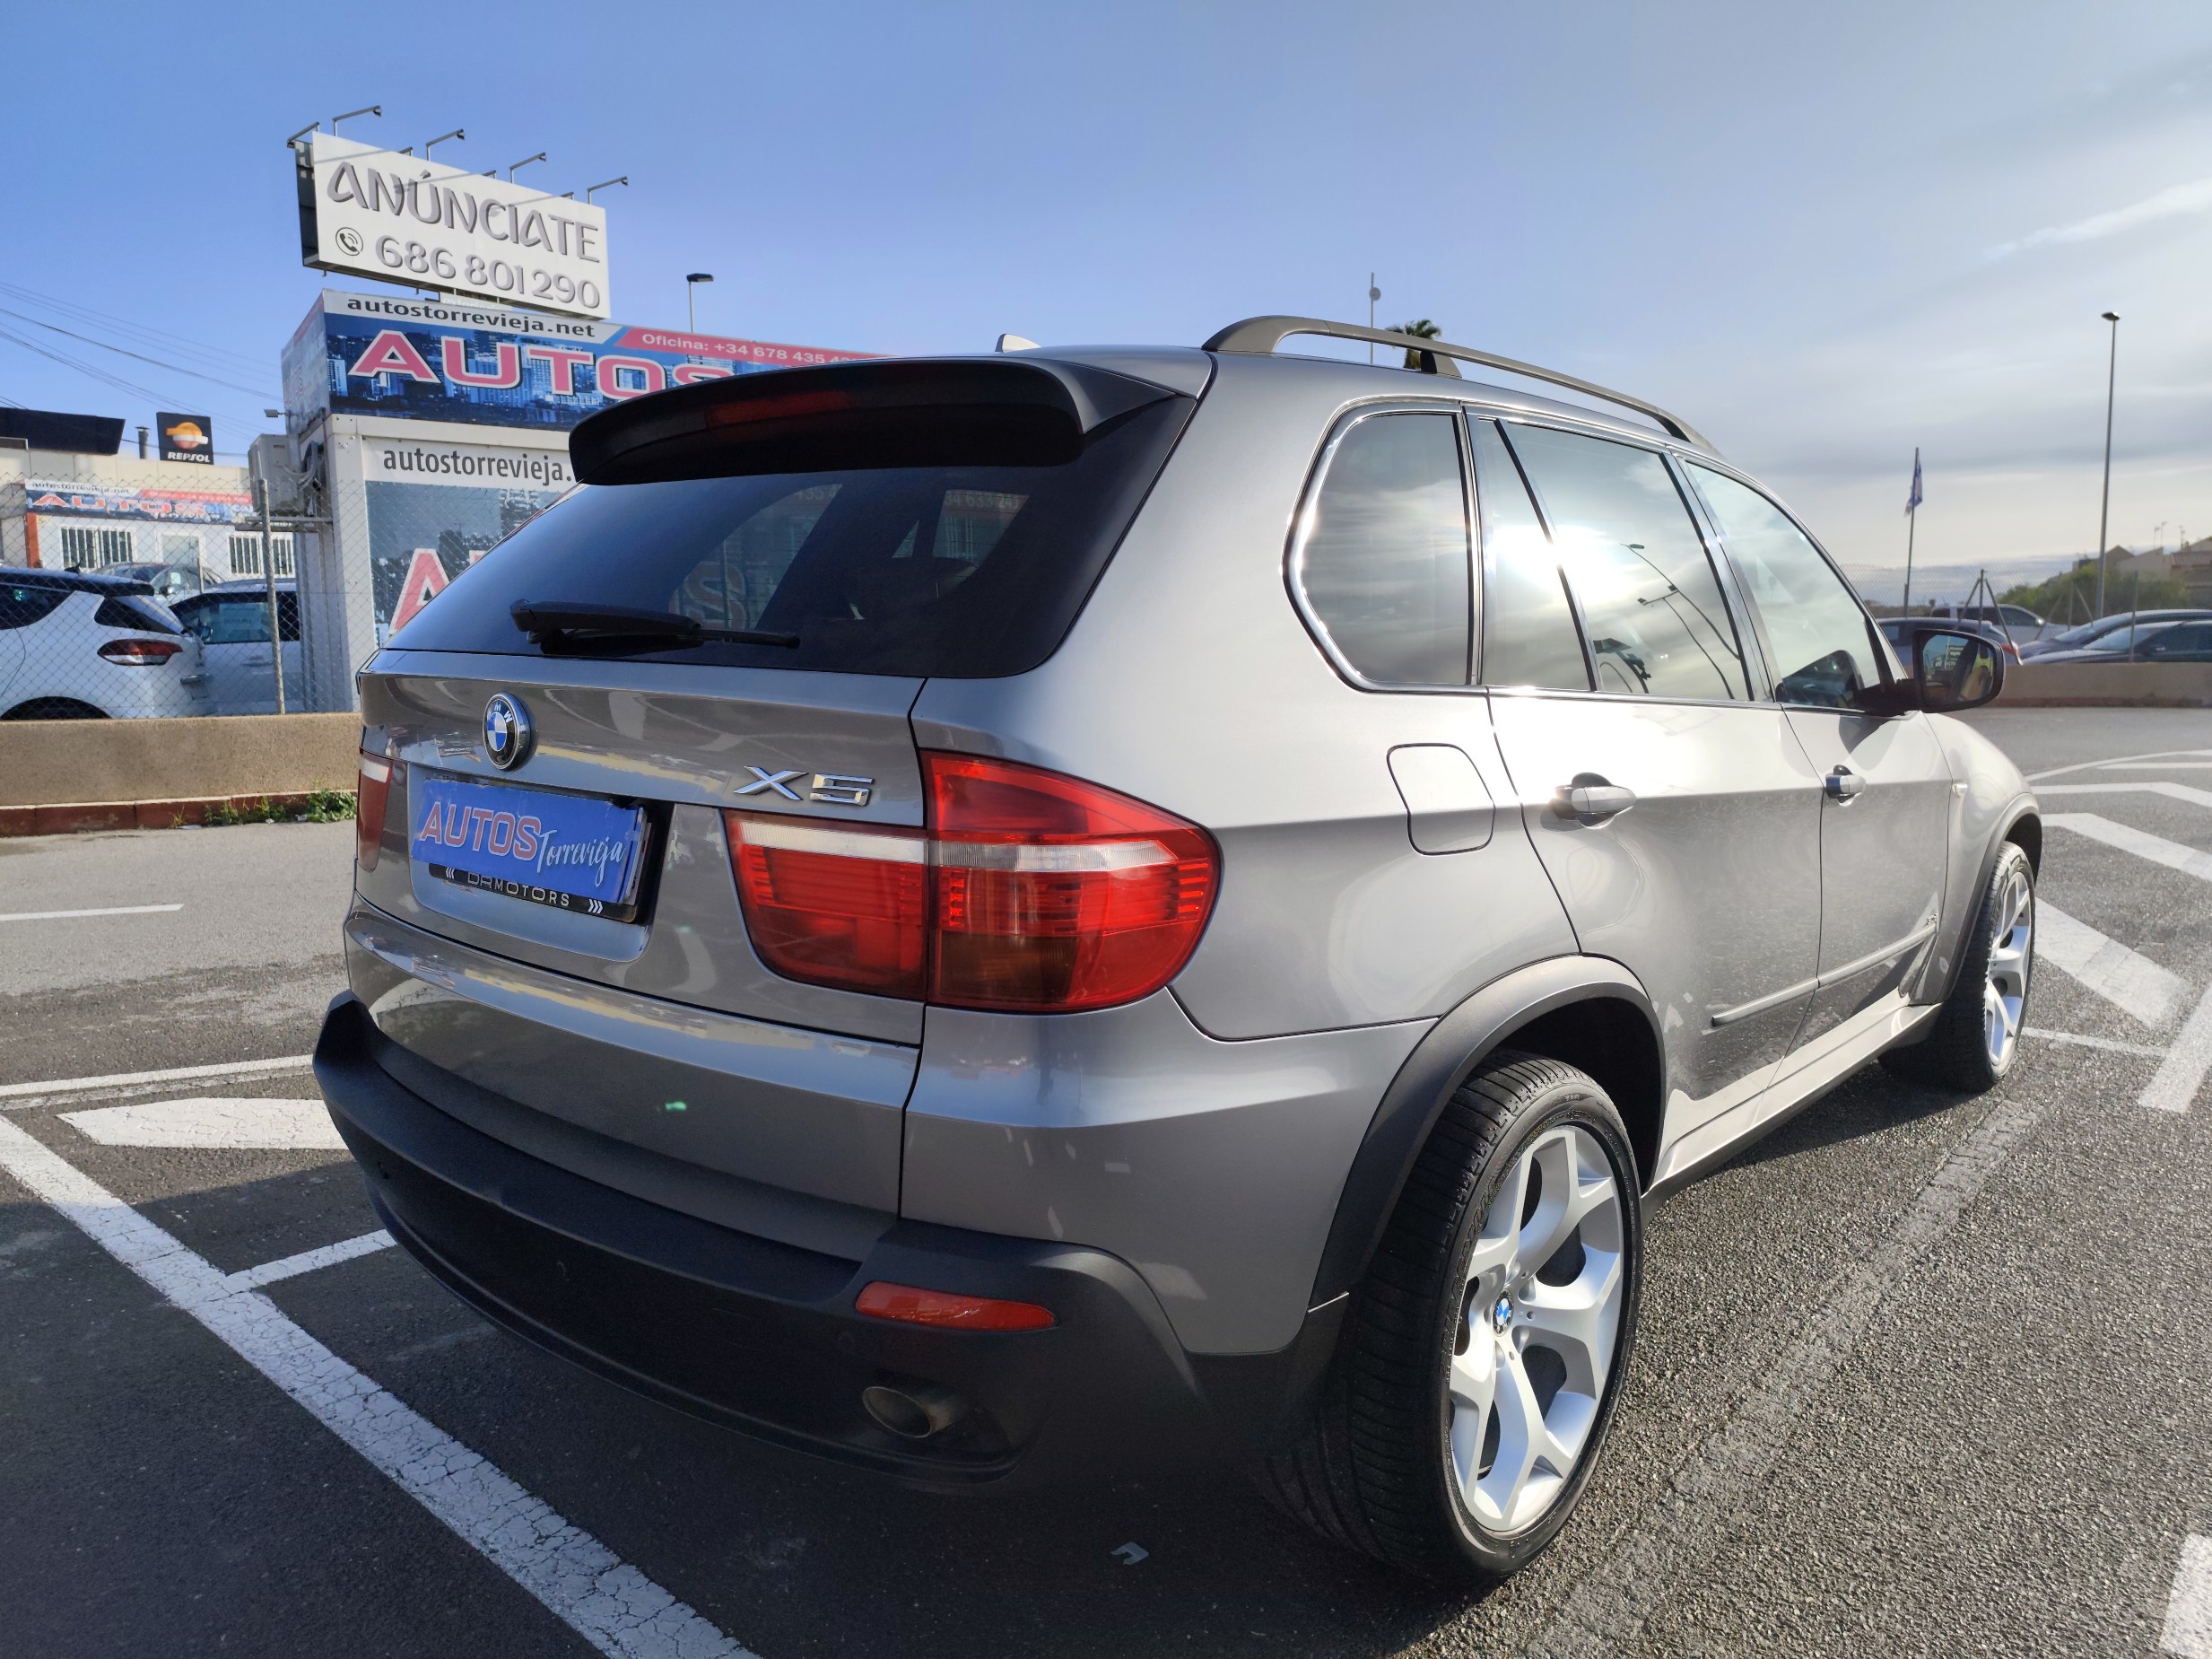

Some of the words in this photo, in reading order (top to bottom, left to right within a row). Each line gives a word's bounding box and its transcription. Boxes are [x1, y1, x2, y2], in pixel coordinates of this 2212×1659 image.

[327, 162, 600, 263] ANÚNCIATE
[375, 234, 457, 279] 686
[464, 253, 525, 294] 801
[531, 268, 600, 309] 290
[347, 297, 595, 337] autostorrevieja.net
[641, 333, 709, 351] Oficina:
[714, 344, 749, 356] +34
[753, 346, 788, 360] 678
[792, 351, 825, 365] 435
[167, 451, 211, 463] REPSOL
[733, 765, 875, 807] X5
[418, 801, 542, 861] AUTOS
[467, 871, 570, 907] DRMOTORS
